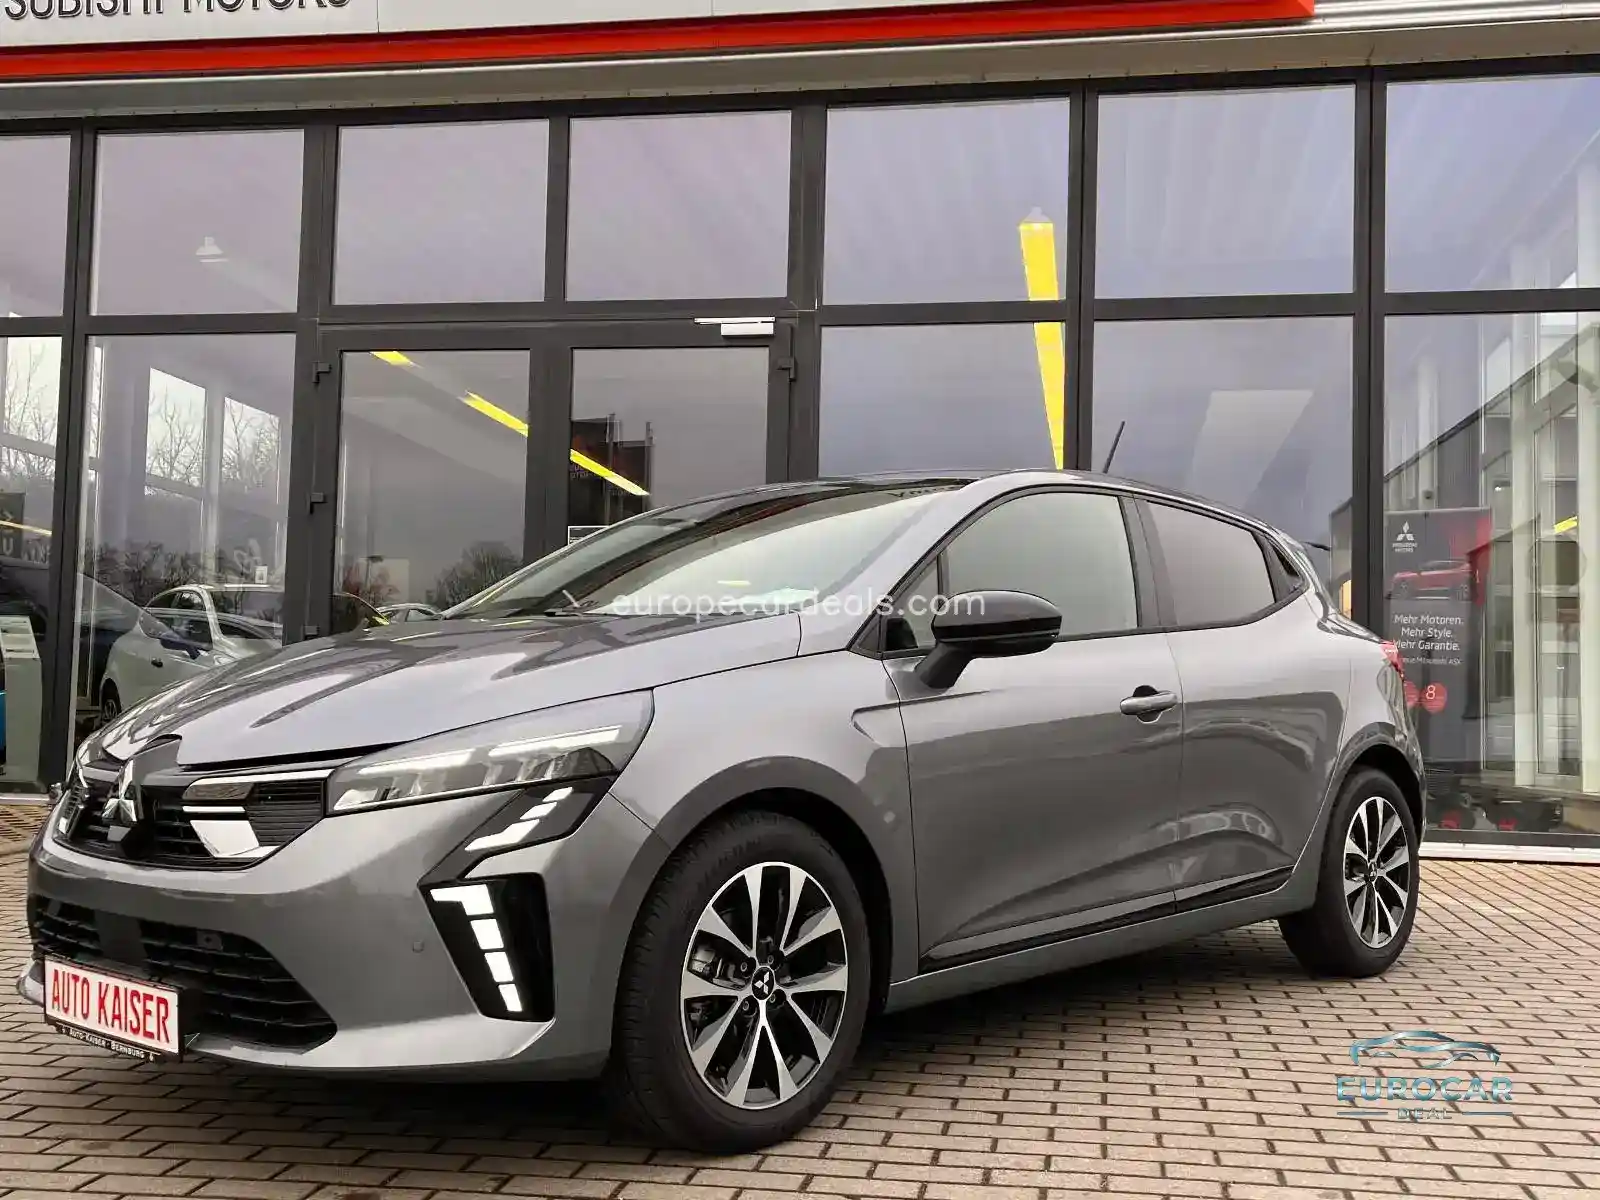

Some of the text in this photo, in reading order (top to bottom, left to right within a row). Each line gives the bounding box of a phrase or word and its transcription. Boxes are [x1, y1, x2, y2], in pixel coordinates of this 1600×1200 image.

[1393, 614, 1464, 625] Mehr Motoren.
[1401, 626, 1453, 639] Mehr Style.
[1418, 640, 1461, 651] Garantie.
[1425, 684, 1436, 700] 8
[52, 968, 170, 1044] AUTO KAISER
